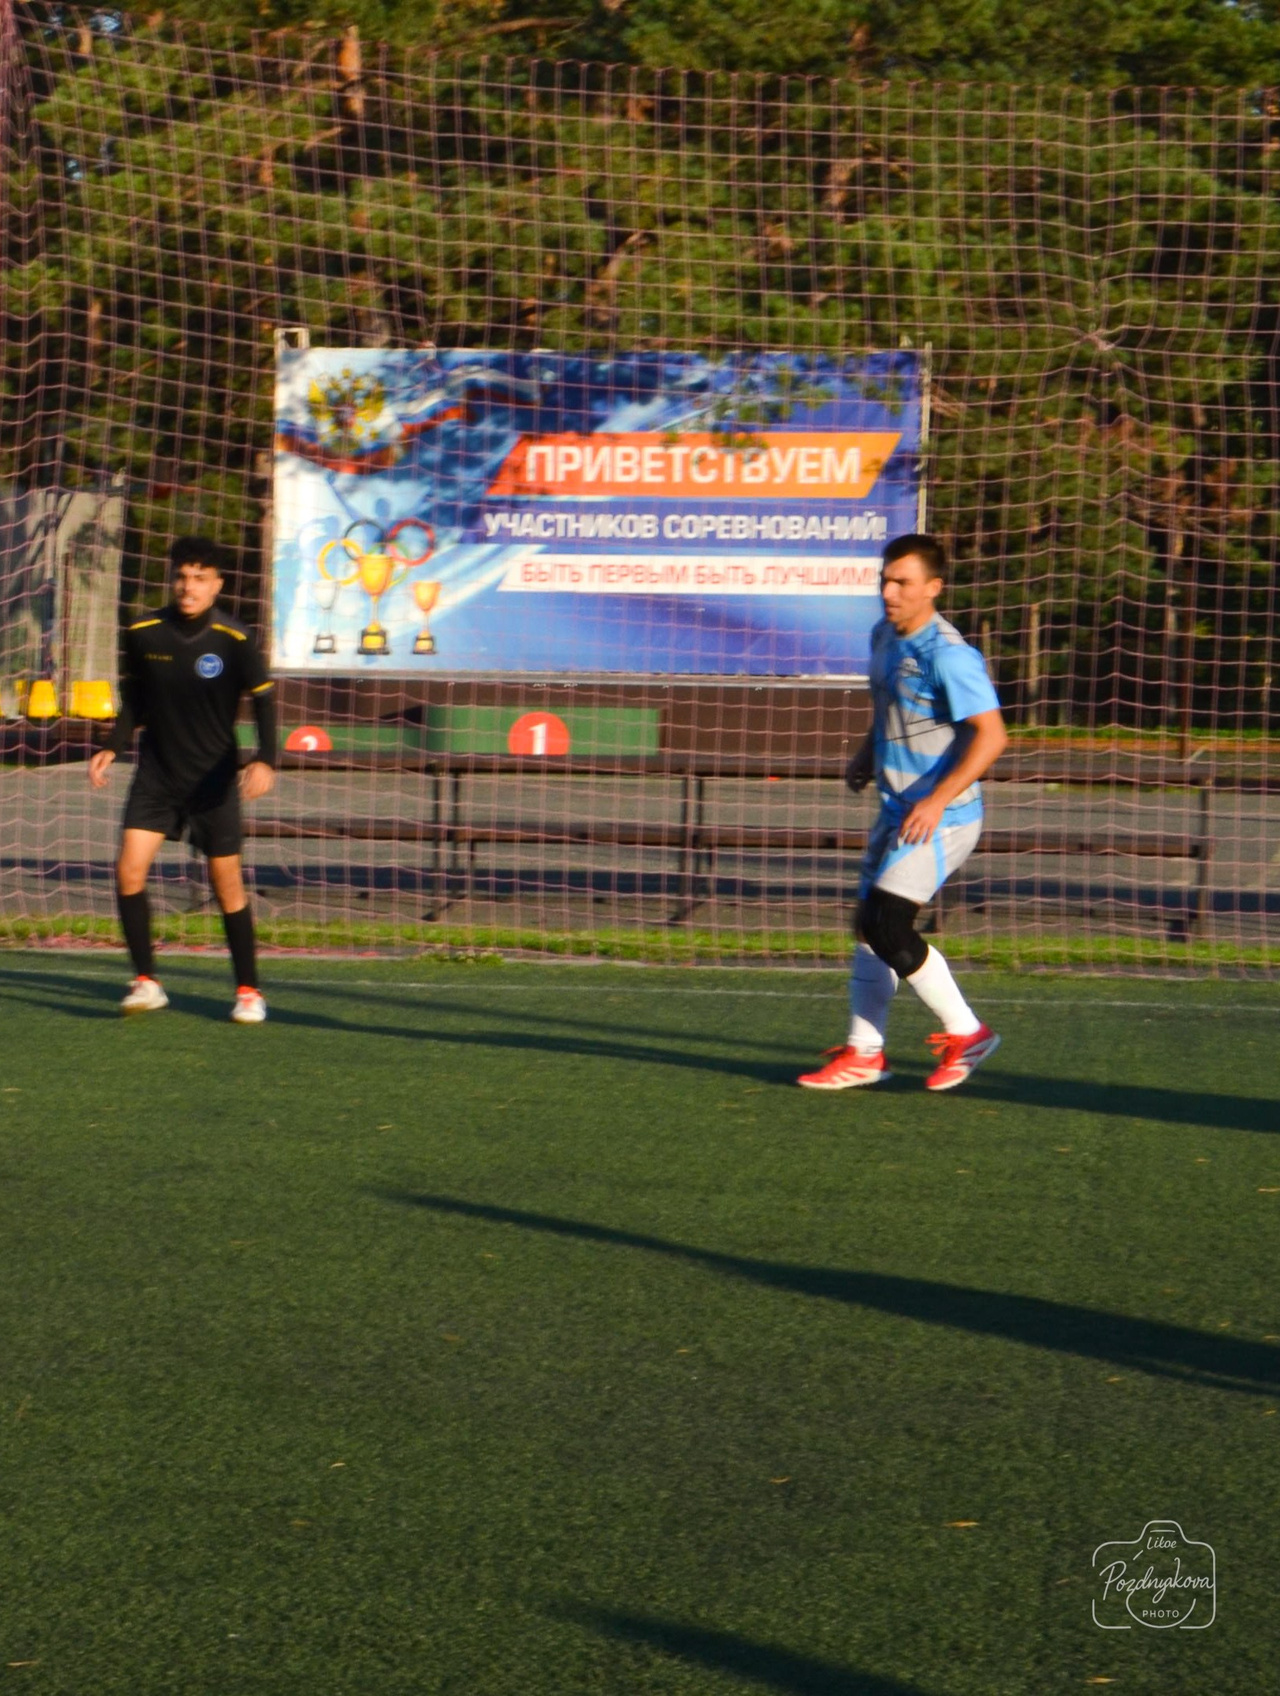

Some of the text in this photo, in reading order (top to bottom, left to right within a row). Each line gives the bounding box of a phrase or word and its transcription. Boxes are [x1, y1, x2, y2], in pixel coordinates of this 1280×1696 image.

[525, 444, 860, 484] ПРИВЕТСТВУЕМ
[484, 512, 660, 539] УЧАСТНИКОВ
[522, 562, 583, 584] БЫТЬ
[588, 563, 688, 585] ПЕРВЫМ
[695, 564, 756, 585] БЫТЬ
[529, 722, 547, 755] 1
